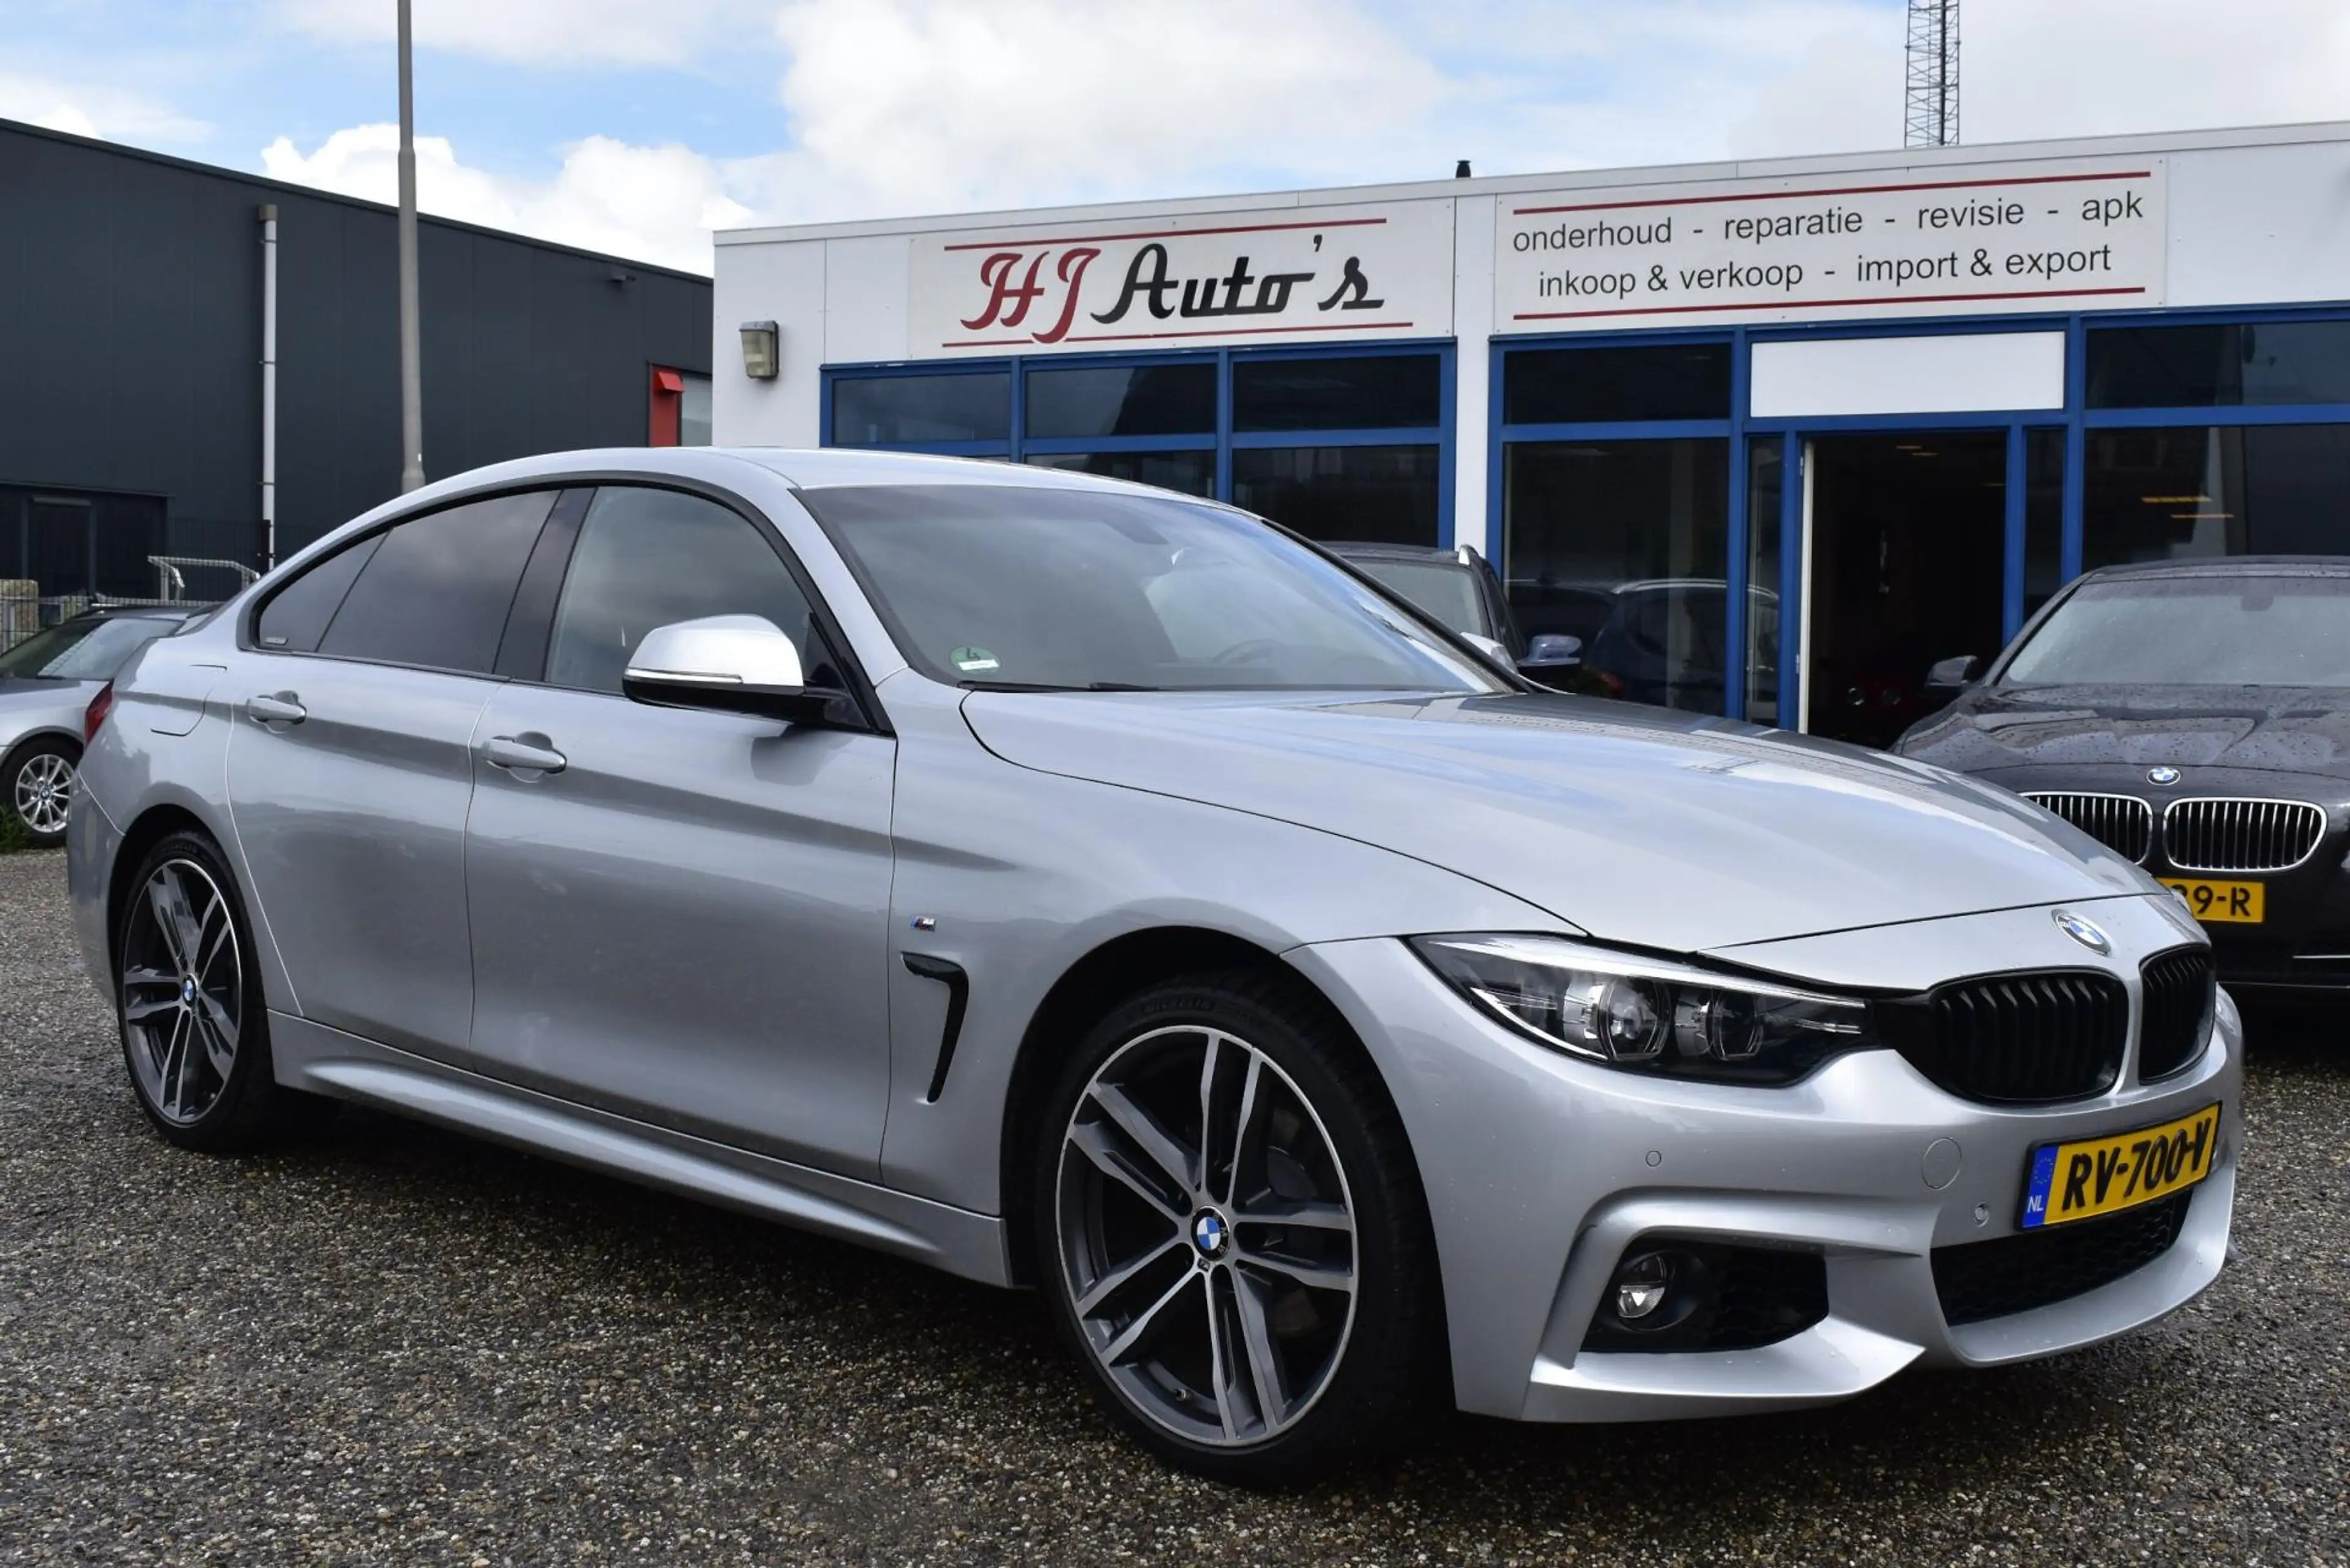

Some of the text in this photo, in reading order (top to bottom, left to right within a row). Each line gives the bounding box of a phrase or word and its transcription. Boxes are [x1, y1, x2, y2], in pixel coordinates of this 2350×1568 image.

[1513, 216, 1672, 252] onderhoud
[1725, 206, 1863, 245] reparatie
[1919, 197, 2024, 230] revisie
[2081, 190, 2143, 228] apk
[1090, 233, 1385, 324] Auto's
[1539, 269, 1636, 301] inkoop
[1647, 264, 1668, 291] &
[1679, 261, 1803, 293] verkoop
[1857, 252, 1958, 288] import
[1970, 248, 1993, 277] &
[2005, 244, 2111, 281] export
[2026, 1194, 2043, 1213] NL
